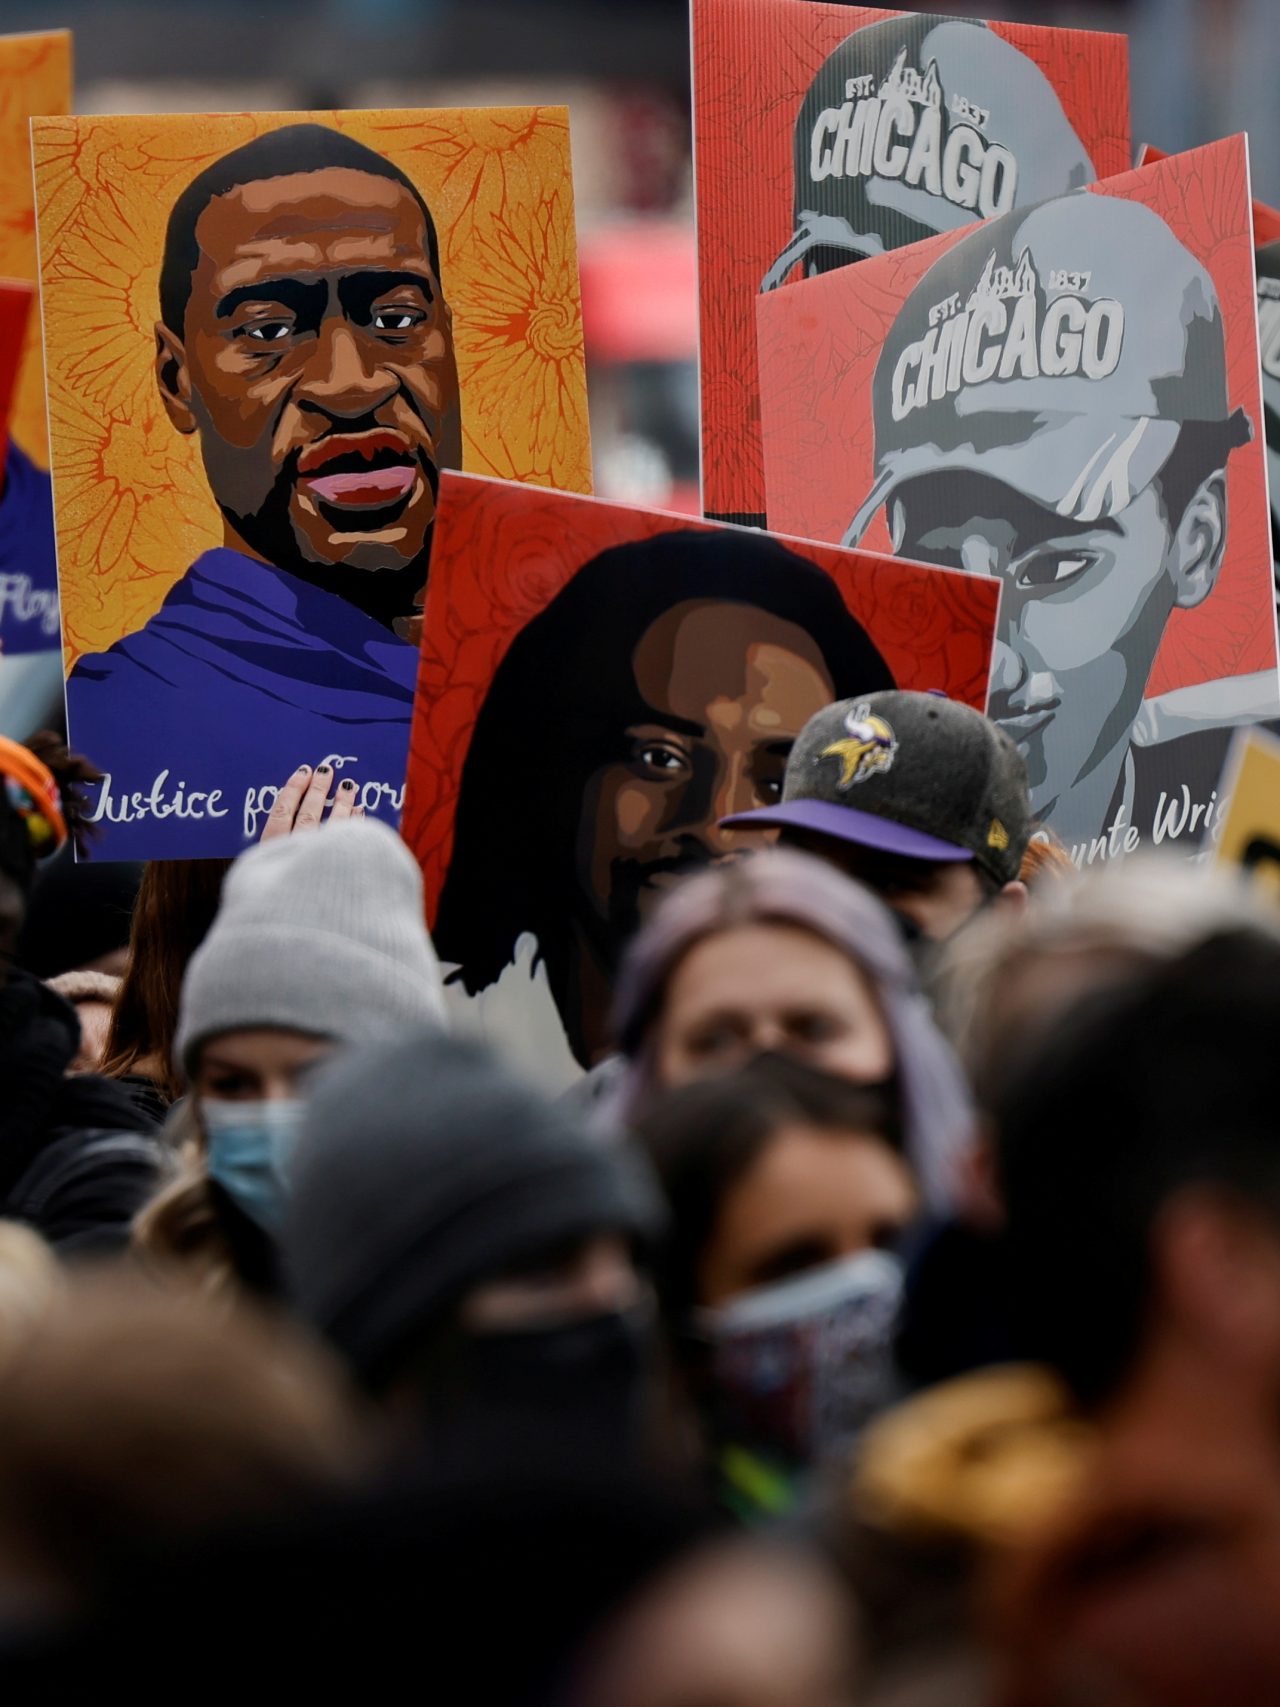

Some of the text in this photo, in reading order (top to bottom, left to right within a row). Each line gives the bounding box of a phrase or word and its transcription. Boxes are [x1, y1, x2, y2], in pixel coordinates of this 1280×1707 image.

[810, 98, 1017, 219] CHICAGO
[1048, 269, 1092, 292] 1837
[891, 296, 1125, 422] CHICAGO
[80, 769, 229, 823] Justice
[242, 785, 284, 838] fo
